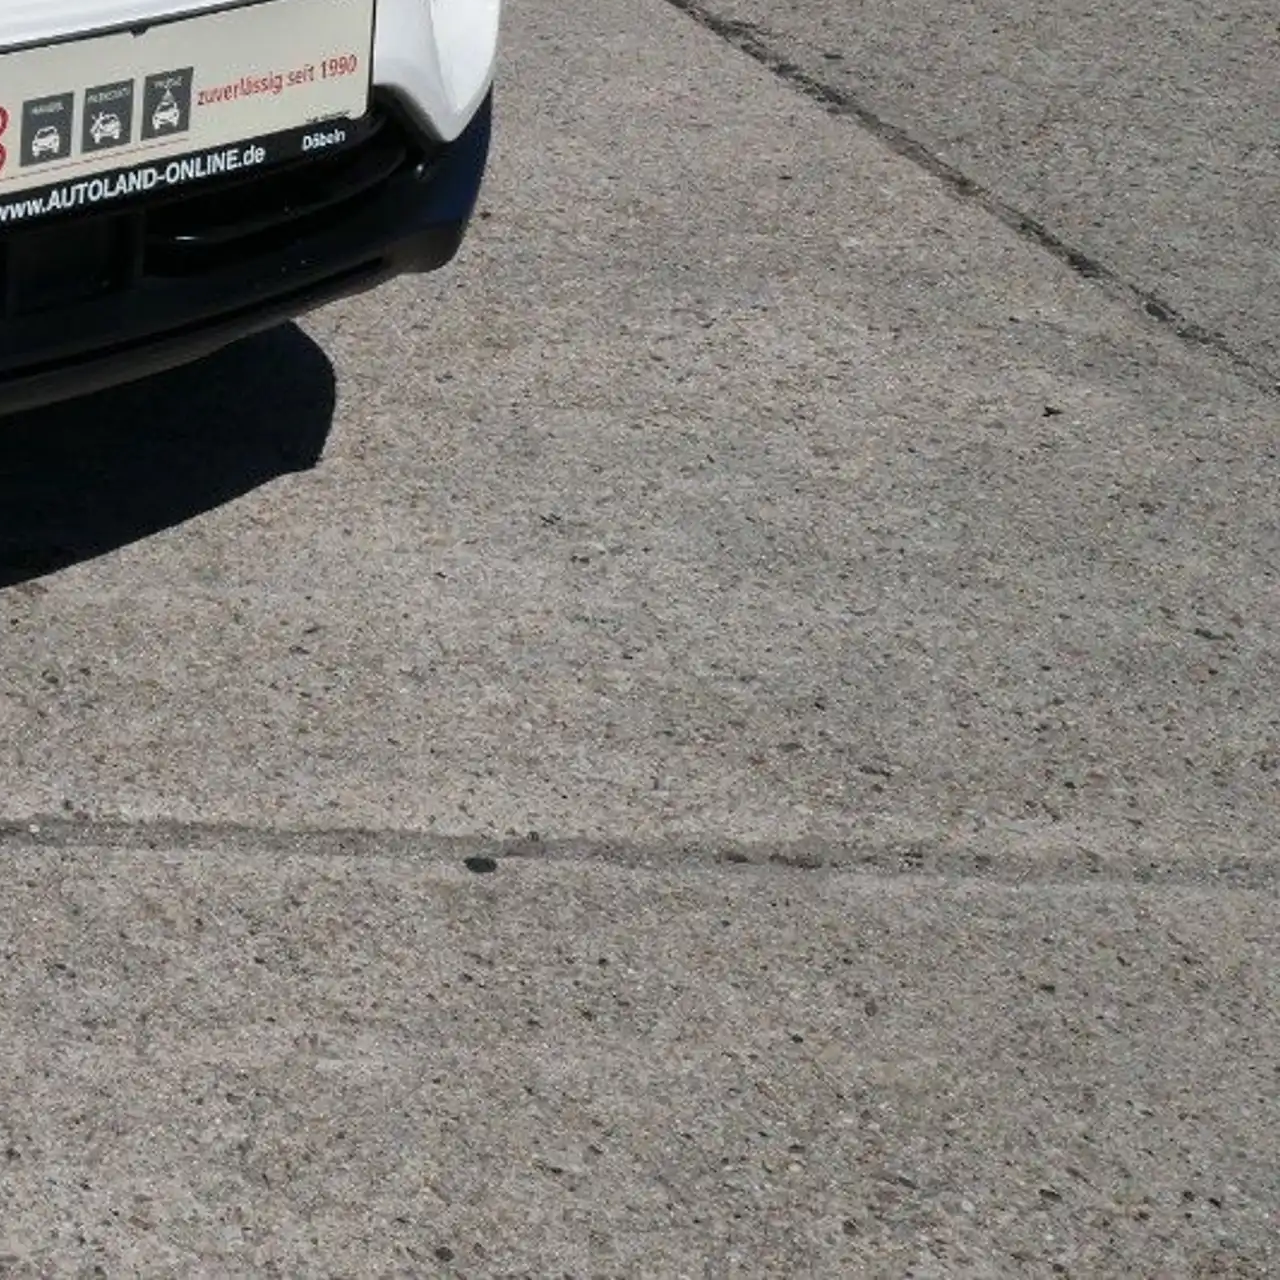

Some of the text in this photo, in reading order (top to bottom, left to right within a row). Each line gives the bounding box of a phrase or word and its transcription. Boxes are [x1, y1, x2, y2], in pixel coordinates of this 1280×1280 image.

[197, 73, 283, 106] zuverlässig
[287, 64, 315, 86] seit
[320, 53, 358, 79] 1990
[301, 128, 346, 151] Döbeln
